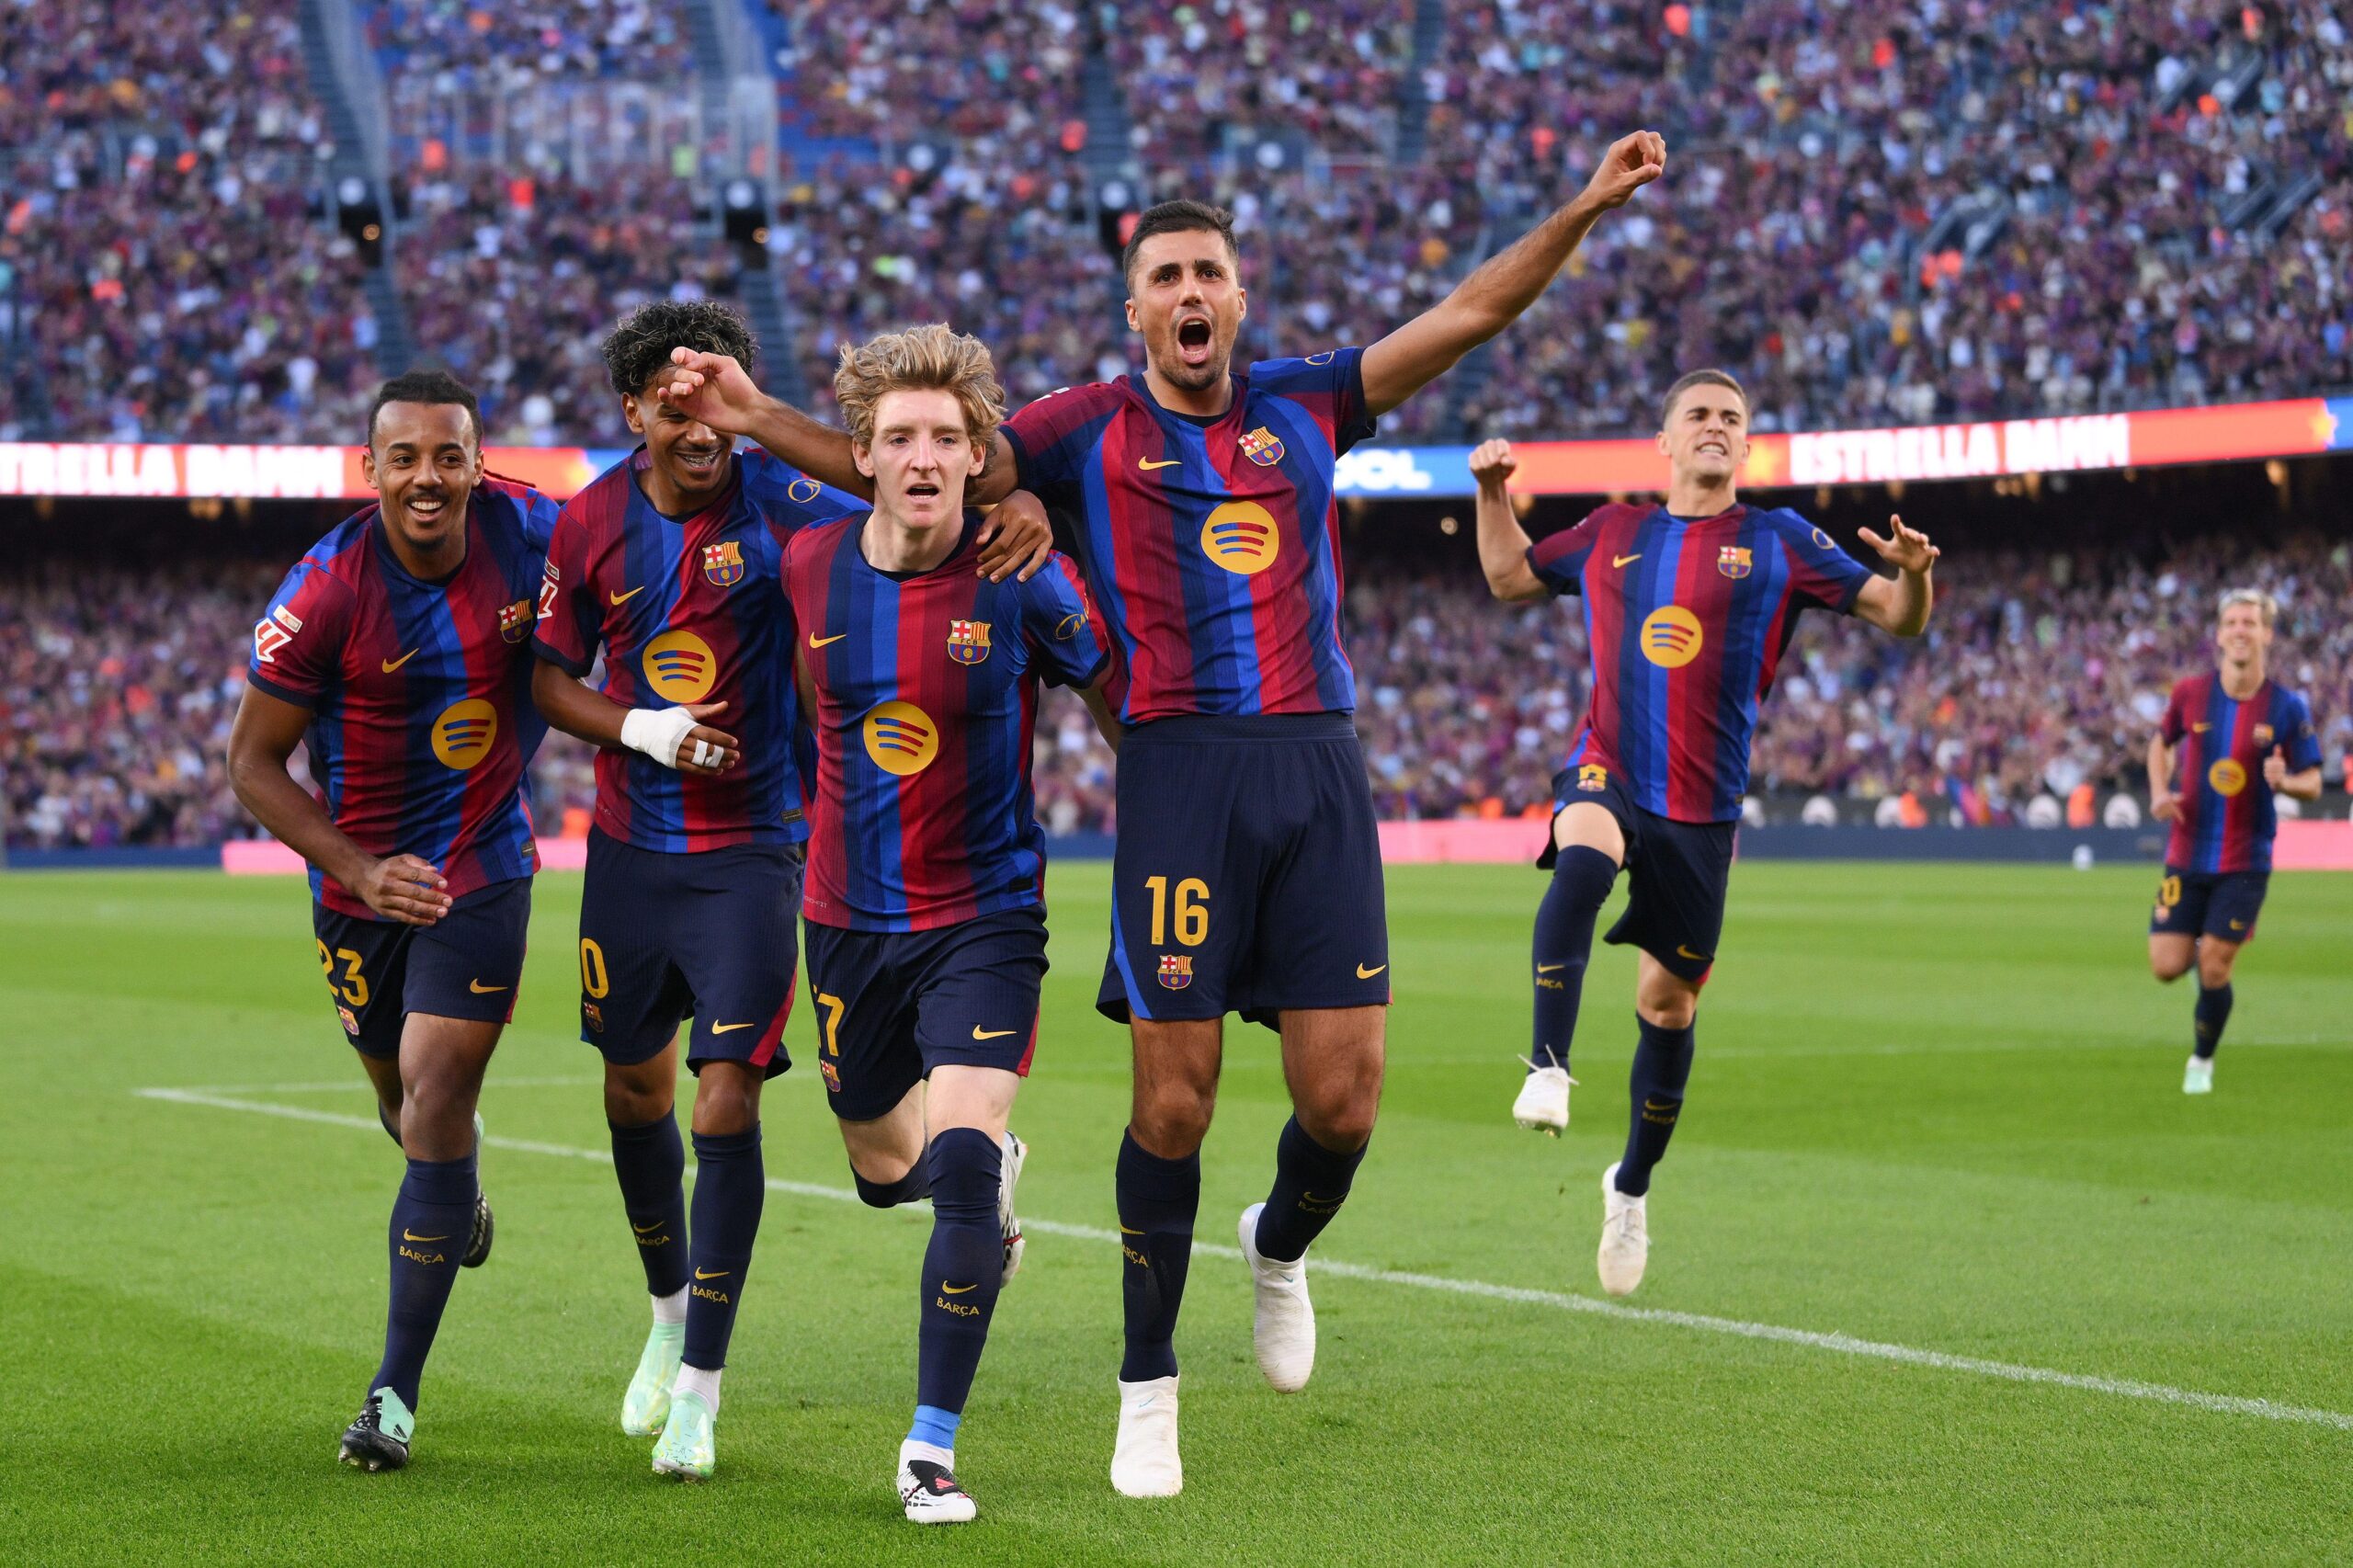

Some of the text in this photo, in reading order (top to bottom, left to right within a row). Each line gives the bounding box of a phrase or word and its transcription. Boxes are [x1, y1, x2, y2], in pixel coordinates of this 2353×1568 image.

[1790, 414, 2129, 483] ESTRELLA DAMM
[1144, 876, 1210, 947] 16
[316, 937, 369, 1006] 23
[399, 1245, 445, 1266] BARÇA
[692, 1285, 729, 1304] BARÇA
[937, 1296, 980, 1317] BARÇA
